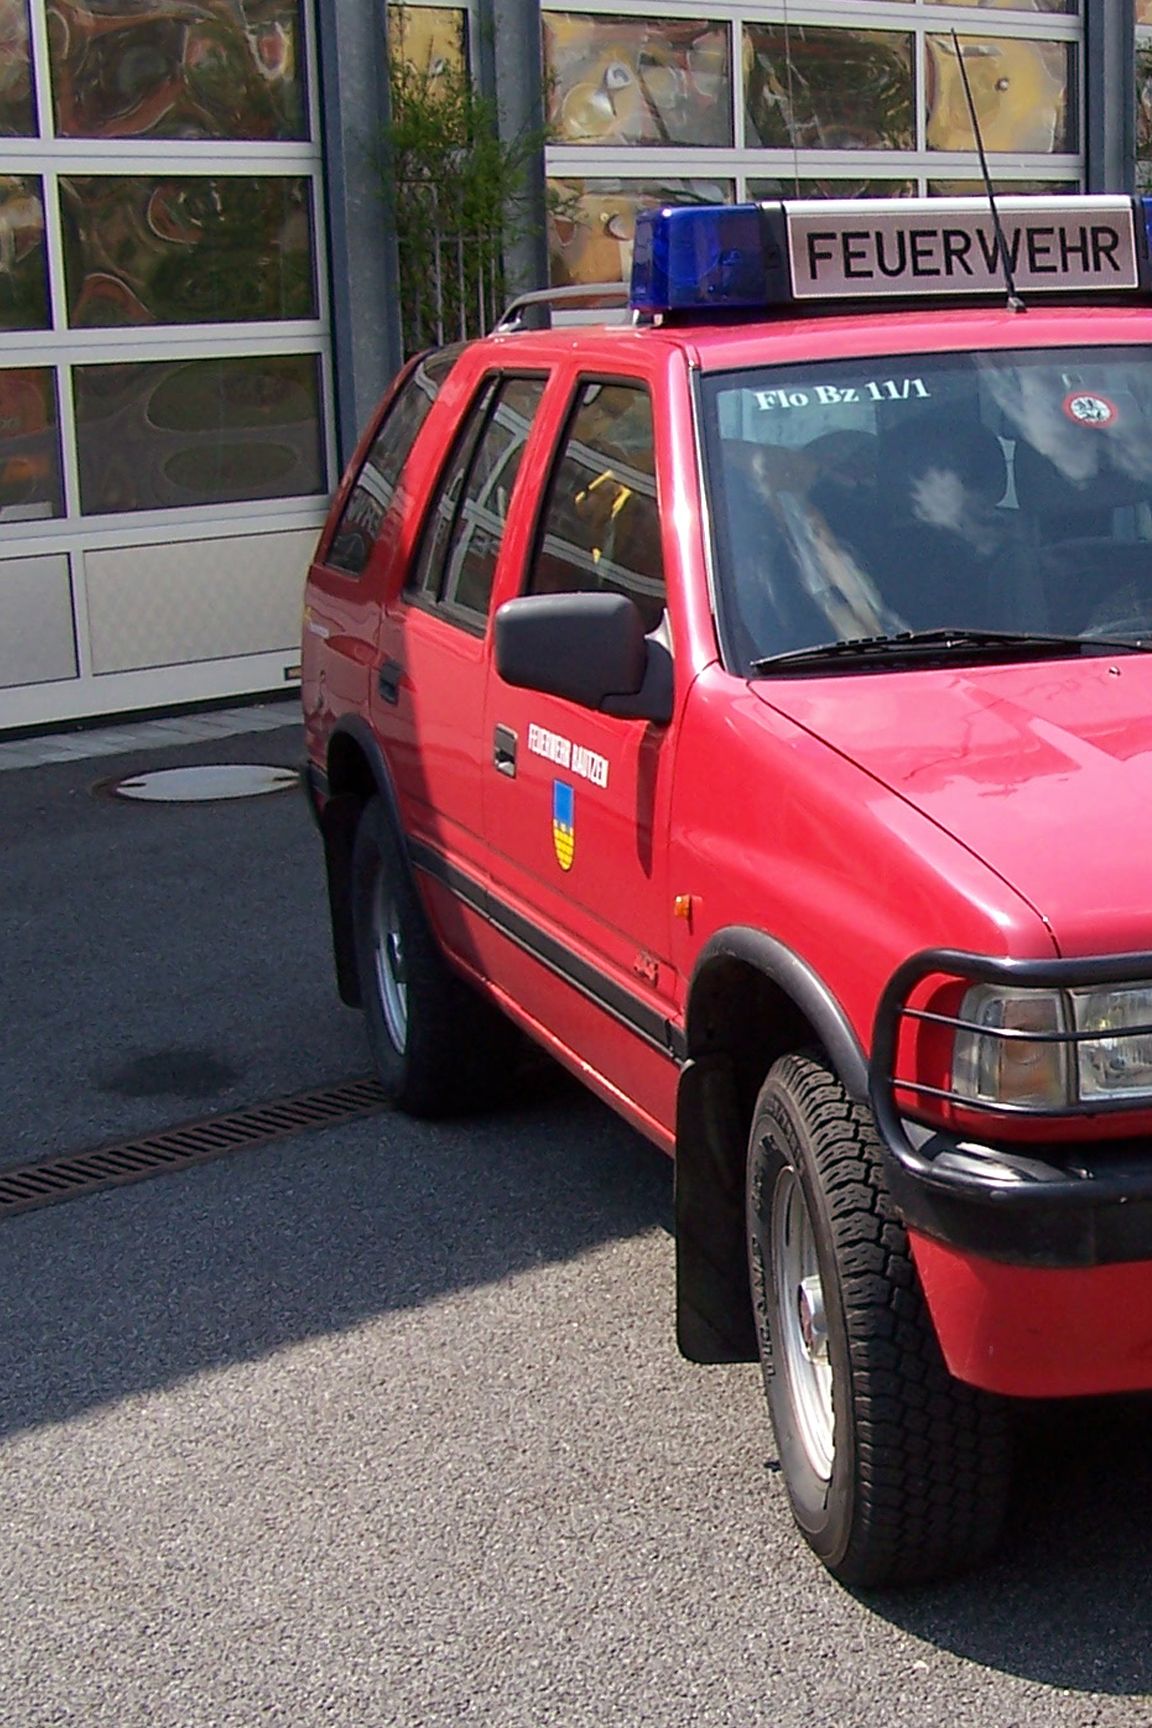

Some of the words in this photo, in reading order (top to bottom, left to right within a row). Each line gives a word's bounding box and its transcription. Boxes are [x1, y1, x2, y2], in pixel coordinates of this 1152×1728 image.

[806, 226, 1121, 280] FEUERWEHR
[754, 388, 809, 411] Flo
[814, 385, 860, 405] Bz
[864, 378, 931, 401] 11/1
